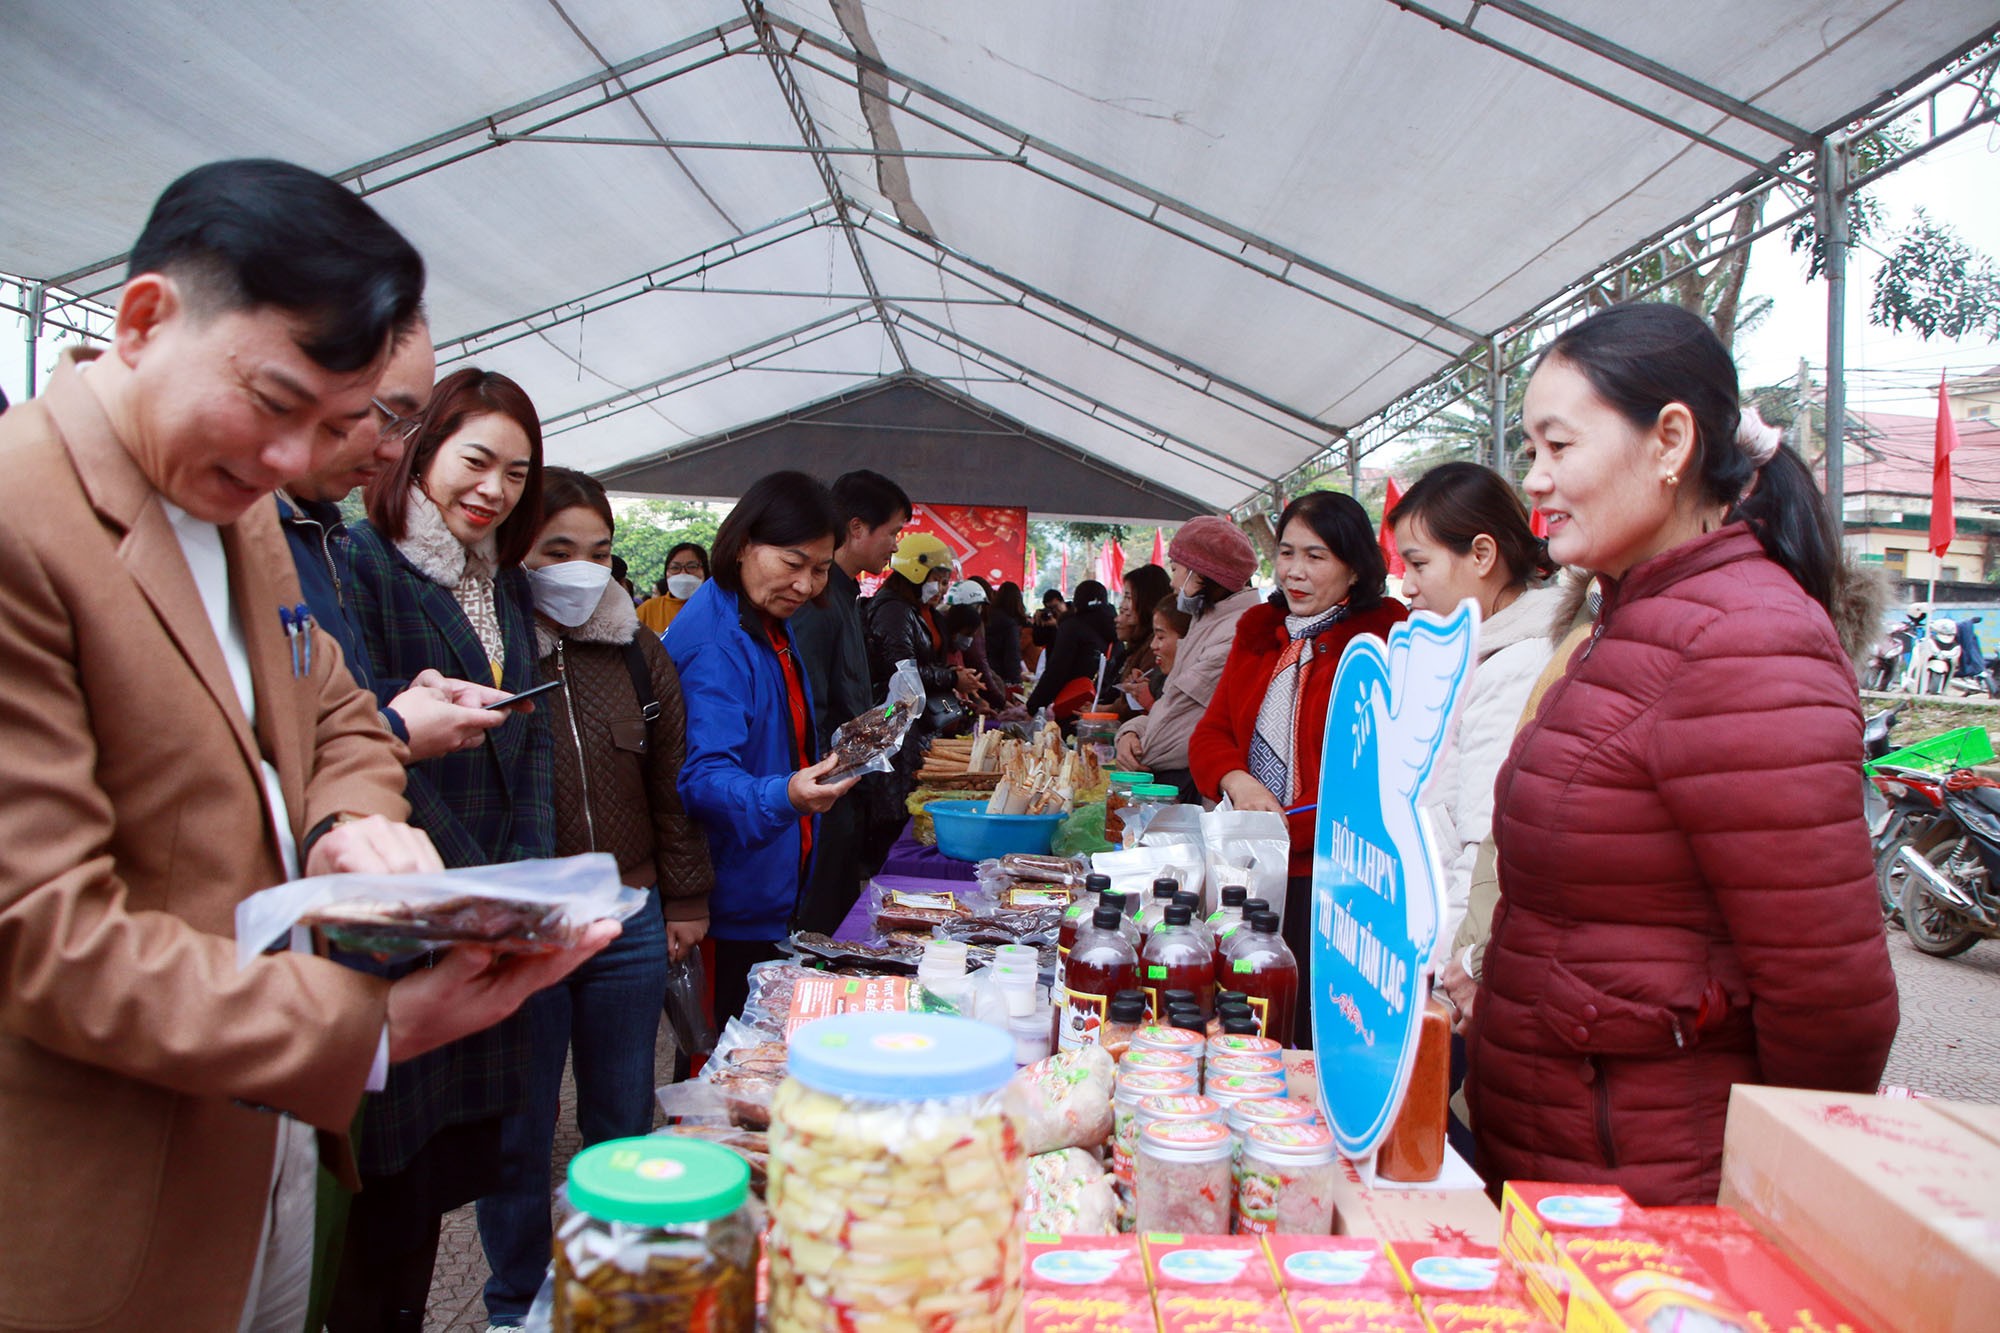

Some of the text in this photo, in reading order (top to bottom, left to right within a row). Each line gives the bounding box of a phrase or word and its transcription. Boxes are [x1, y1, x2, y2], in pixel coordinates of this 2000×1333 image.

[1331, 816, 1397, 905] HỘI LHPN
[881, 979, 895, 997] THỊT
[1318, 890, 1407, 1017] THỊ TRẤN TÂN LẠC
